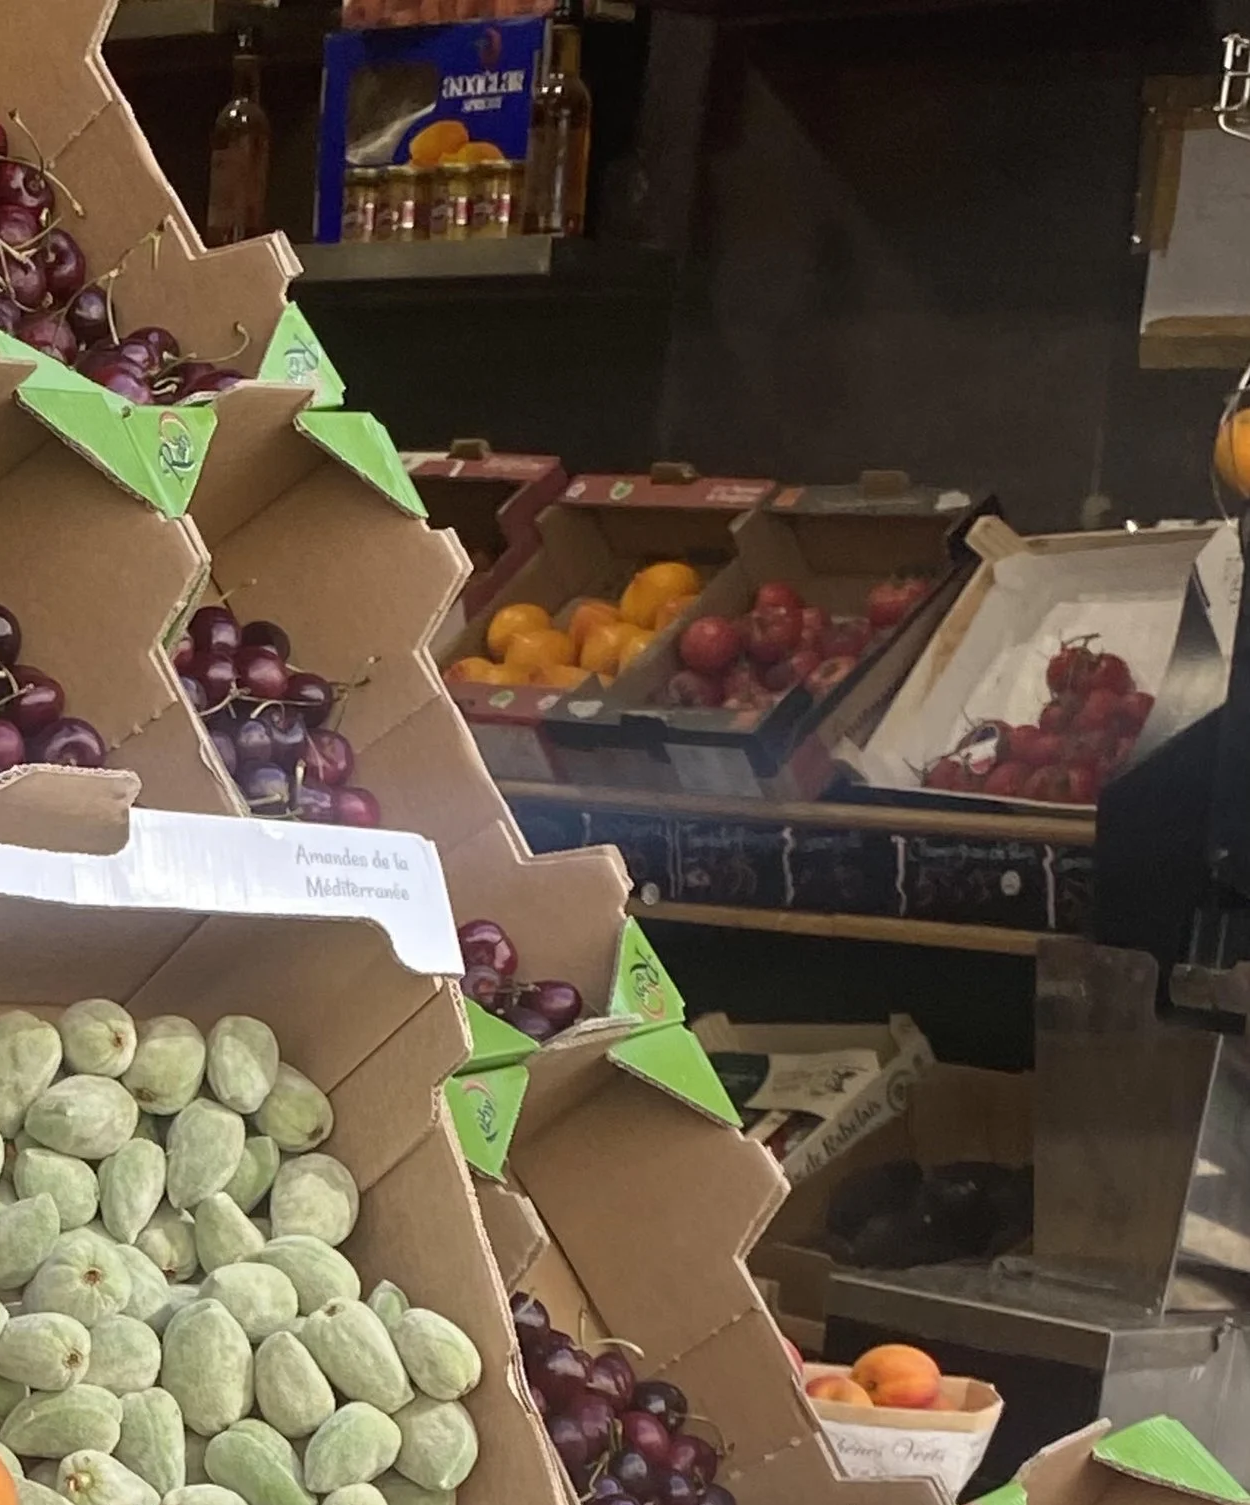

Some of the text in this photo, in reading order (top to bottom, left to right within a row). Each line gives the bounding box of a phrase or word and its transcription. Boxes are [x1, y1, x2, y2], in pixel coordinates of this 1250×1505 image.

[295, 843, 410, 871] Amandes de la
